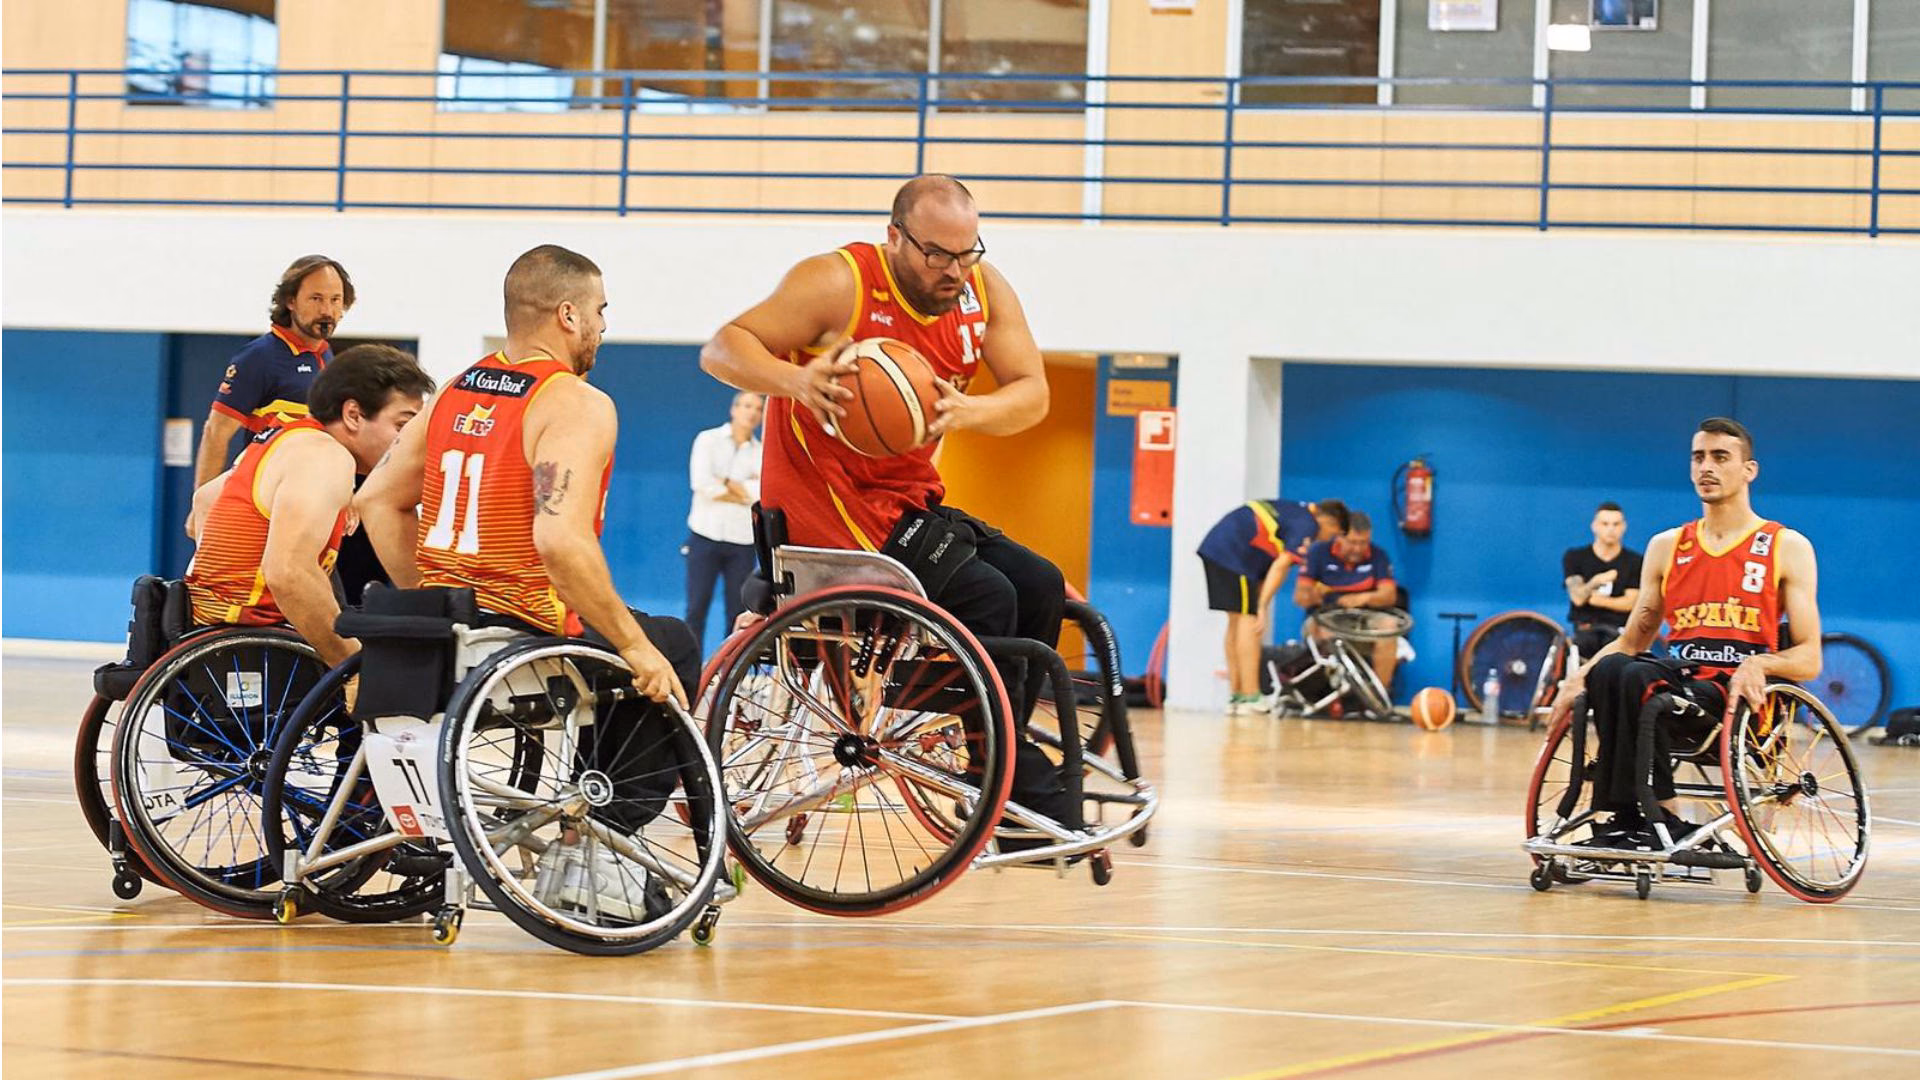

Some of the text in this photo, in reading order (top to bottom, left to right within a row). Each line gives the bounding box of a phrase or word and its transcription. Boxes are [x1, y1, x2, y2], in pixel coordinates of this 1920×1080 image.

[423, 449, 485, 555] 11
[1741, 561, 1767, 594] 8
[1681, 643, 1756, 663] CaixaBa
[391, 758, 432, 807] 11
